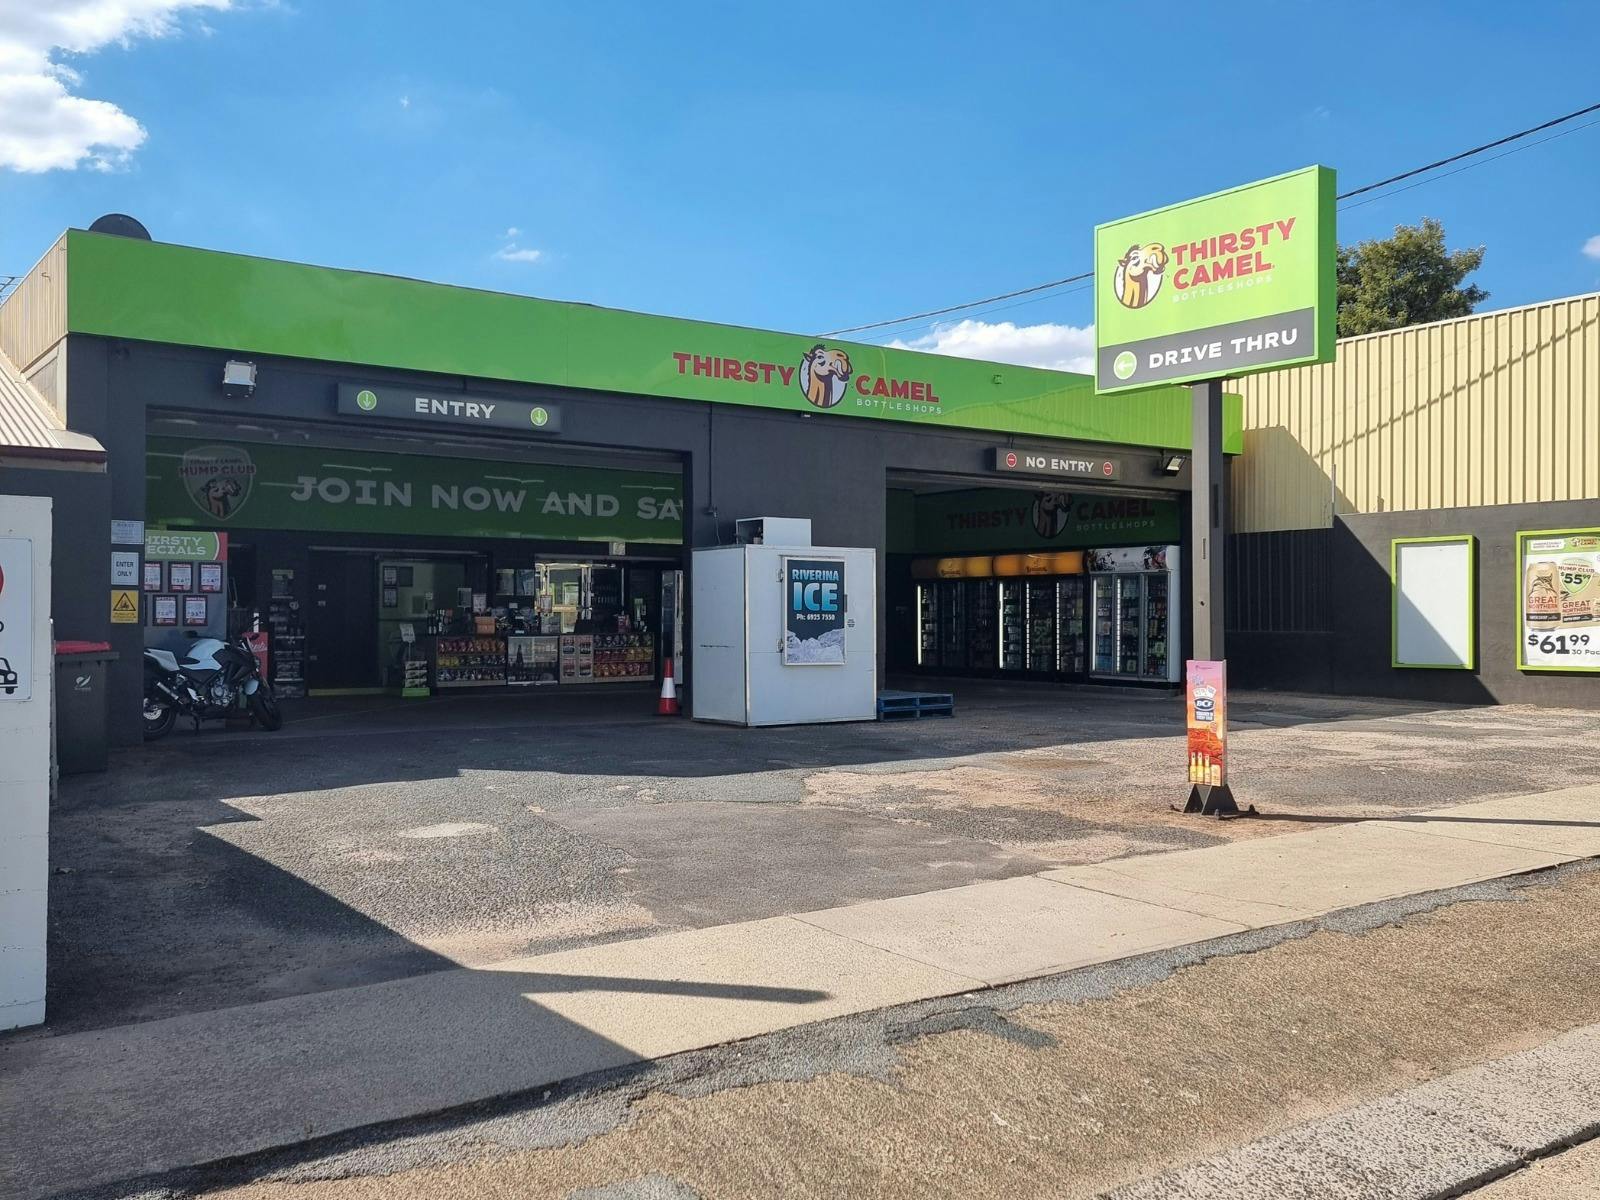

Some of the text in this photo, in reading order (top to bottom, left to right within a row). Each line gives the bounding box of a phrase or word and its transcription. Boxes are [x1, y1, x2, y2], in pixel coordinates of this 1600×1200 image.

[1171, 217, 1296, 266] THIRSTY
[1173, 251, 1272, 290] CAMEL
[1172, 274, 1273, 304] BOTTLESHOPS
[1149, 328, 1298, 369] DRIVE THRU
[672, 351, 939, 403] THIRSTY CAMEL
[415, 397, 496, 420] ENTRY
[856, 398, 942, 415] BOTTLESHOPS
[177, 464, 257, 477] HUMP CLUB
[1025, 456, 1095, 473] NO ENTRY
[290, 476, 412, 508] JOIN
[432, 484, 527, 513] NOW
[541, 491, 620, 517] AND
[946, 499, 1156, 530] THIRSTY CAMEL
[1076, 519, 1156, 532] BOTTLESHOPS
[147, 545, 207, 556] ECIALS
[792, 569, 839, 582] RIVERINA
[793, 582, 838, 612] ICE
[1528, 596, 1558, 604] GREAT
[1562, 600, 1591, 609] GREAT
[1196, 700, 1213, 708] BCF
